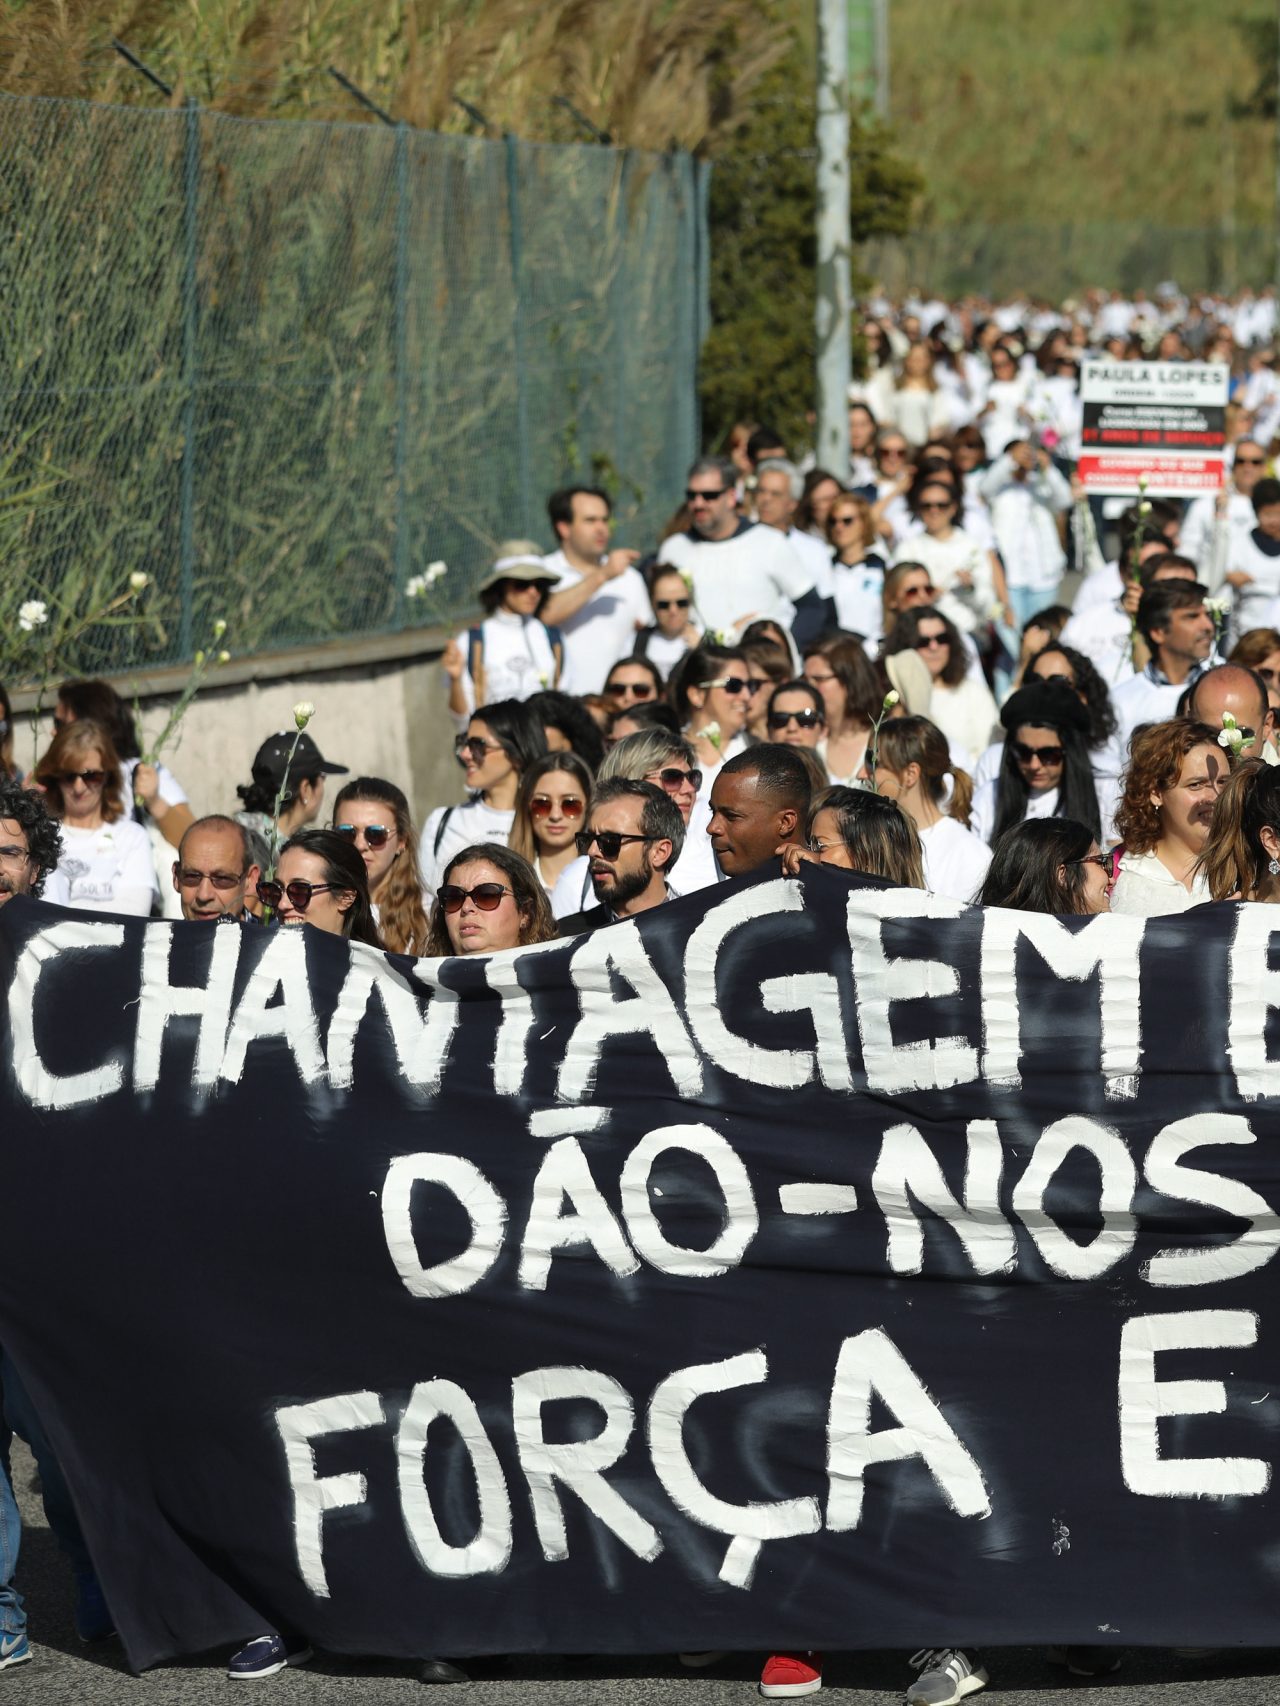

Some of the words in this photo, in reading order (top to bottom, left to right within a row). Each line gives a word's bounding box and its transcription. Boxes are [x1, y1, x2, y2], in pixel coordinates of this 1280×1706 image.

[1087, 367, 1151, 383] PAULA
[1158, 369, 1223, 385] LOPES
[7, 876, 1146, 1112] CHANTAGEM
[274, 1326, 994, 1598] FORÇA
[1117, 1308, 1272, 1502] E
